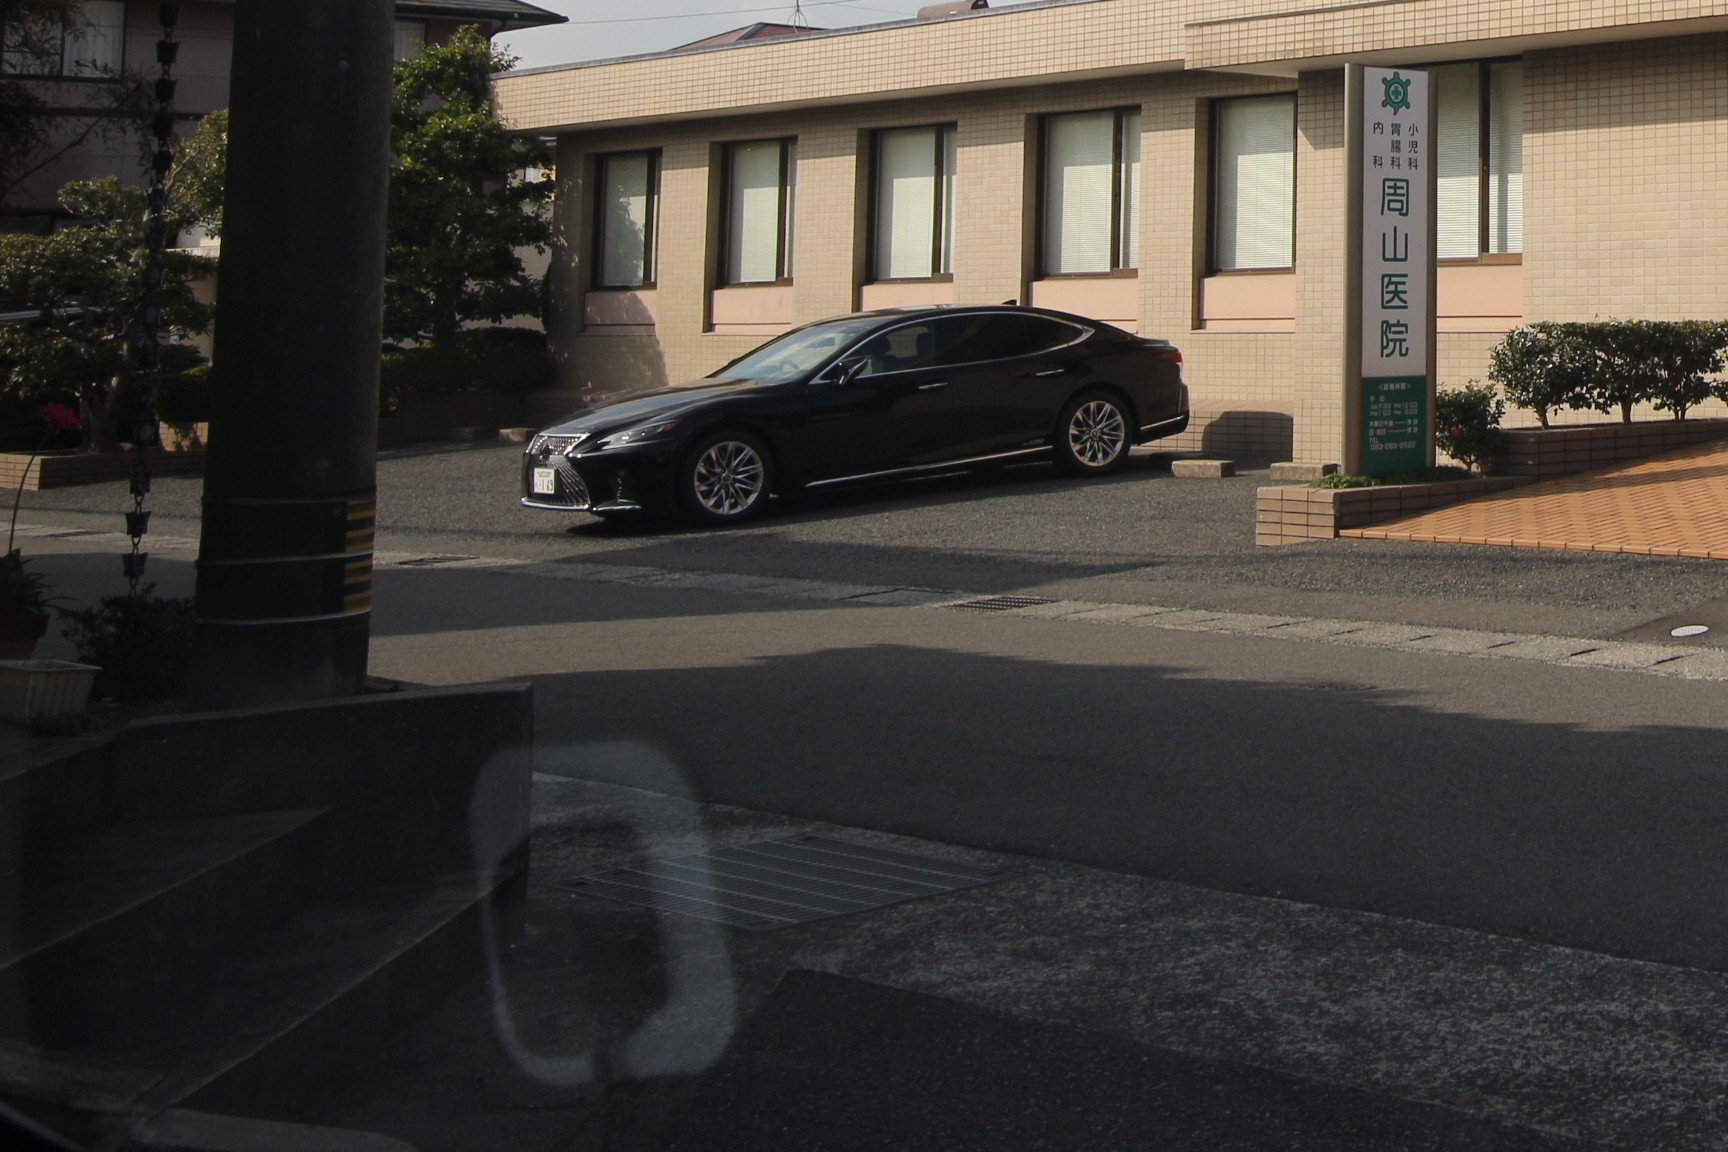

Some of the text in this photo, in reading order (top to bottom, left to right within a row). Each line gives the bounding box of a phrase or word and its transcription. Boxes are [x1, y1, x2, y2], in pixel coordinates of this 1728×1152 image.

[1372, 120, 1384, 169] 内科
[1390, 122, 1402, 170] 胃腸科
[1407, 122, 1419, 171] 小児科
[1380, 177, 1410, 359] 周山医院
